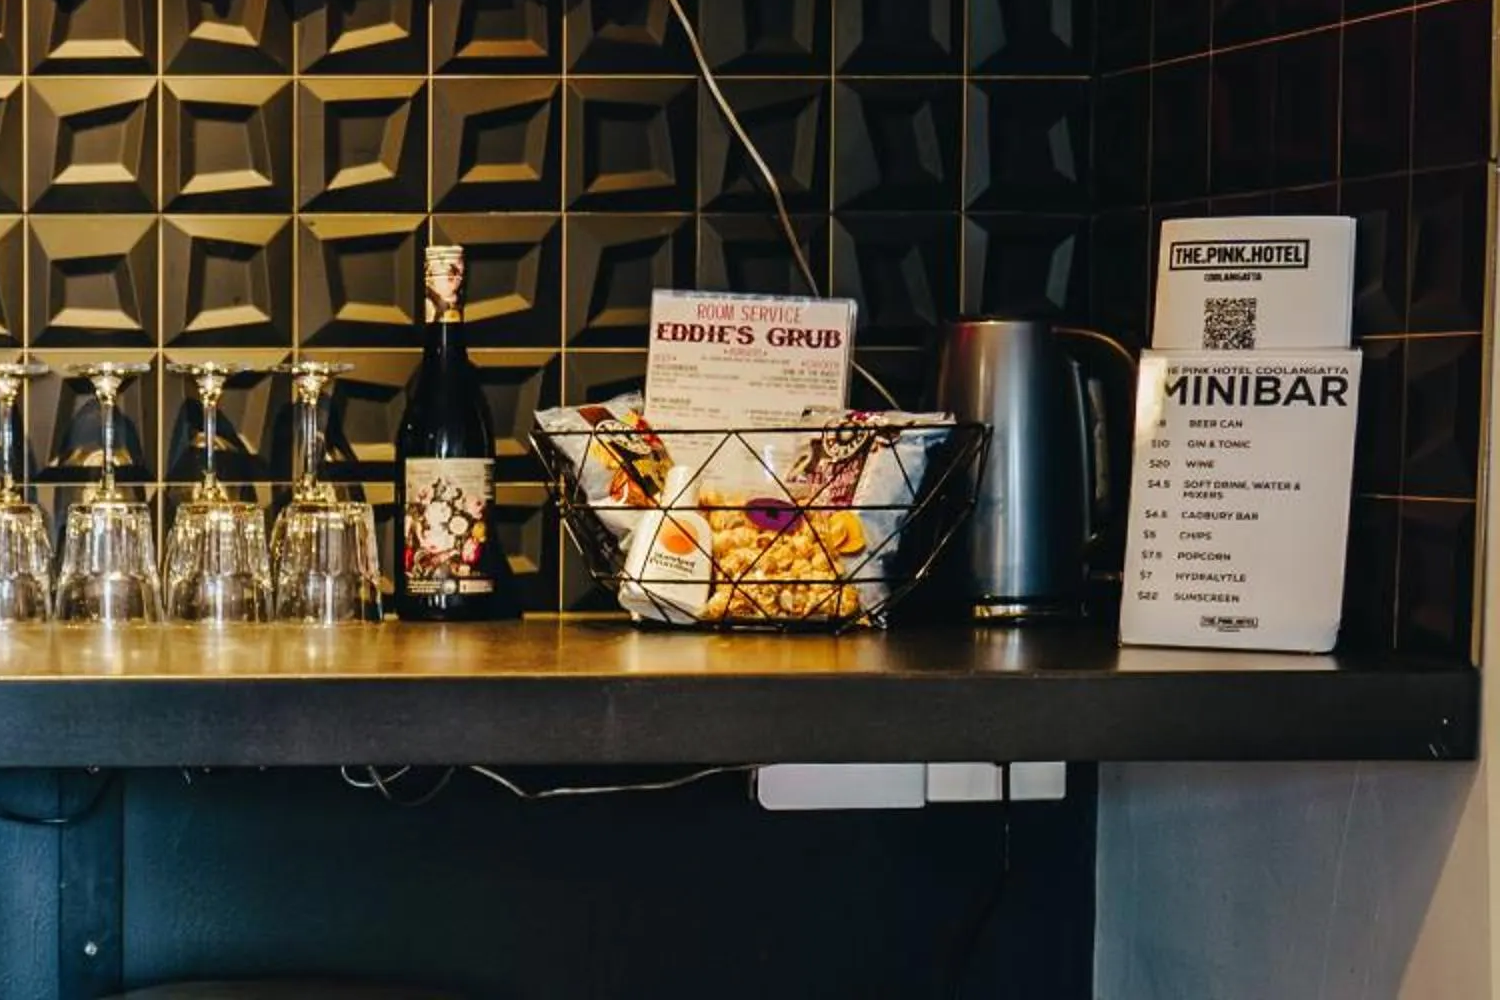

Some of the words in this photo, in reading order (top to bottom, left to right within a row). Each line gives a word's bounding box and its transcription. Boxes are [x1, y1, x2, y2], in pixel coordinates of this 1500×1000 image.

[697, 304, 734, 321] ROOM
[741, 306, 801, 324] SERVICE
[656, 322, 755, 345] EDDIE'S
[765, 327, 842, 349] GRUB
[1182, 367, 1209, 375] PINK
[1212, 367, 1252, 375] HOTEL
[1255, 366, 1349, 376] COOLANGATTA
[1189, 419, 1217, 429] BEER
[1220, 420, 1243, 429] CAN
[1187, 440, 1207, 449] GIN
[1218, 440, 1252, 449] TONIC
[1148, 459, 1171, 469] $20
[1185, 460, 1215, 469] WINE
[1183, 480, 1212, 490] SOFT
[1252, 482, 1291, 491] WATER
[1182, 490, 1224, 500] MIXERS
[1181, 511, 1233, 521] CADBURY
[1235, 512, 1259, 521] BAR
[1179, 530, 1212, 541] CHIPS
[1177, 551, 1231, 561] POPCORN
[1174, 592, 1240, 604] SUNSCREEN
